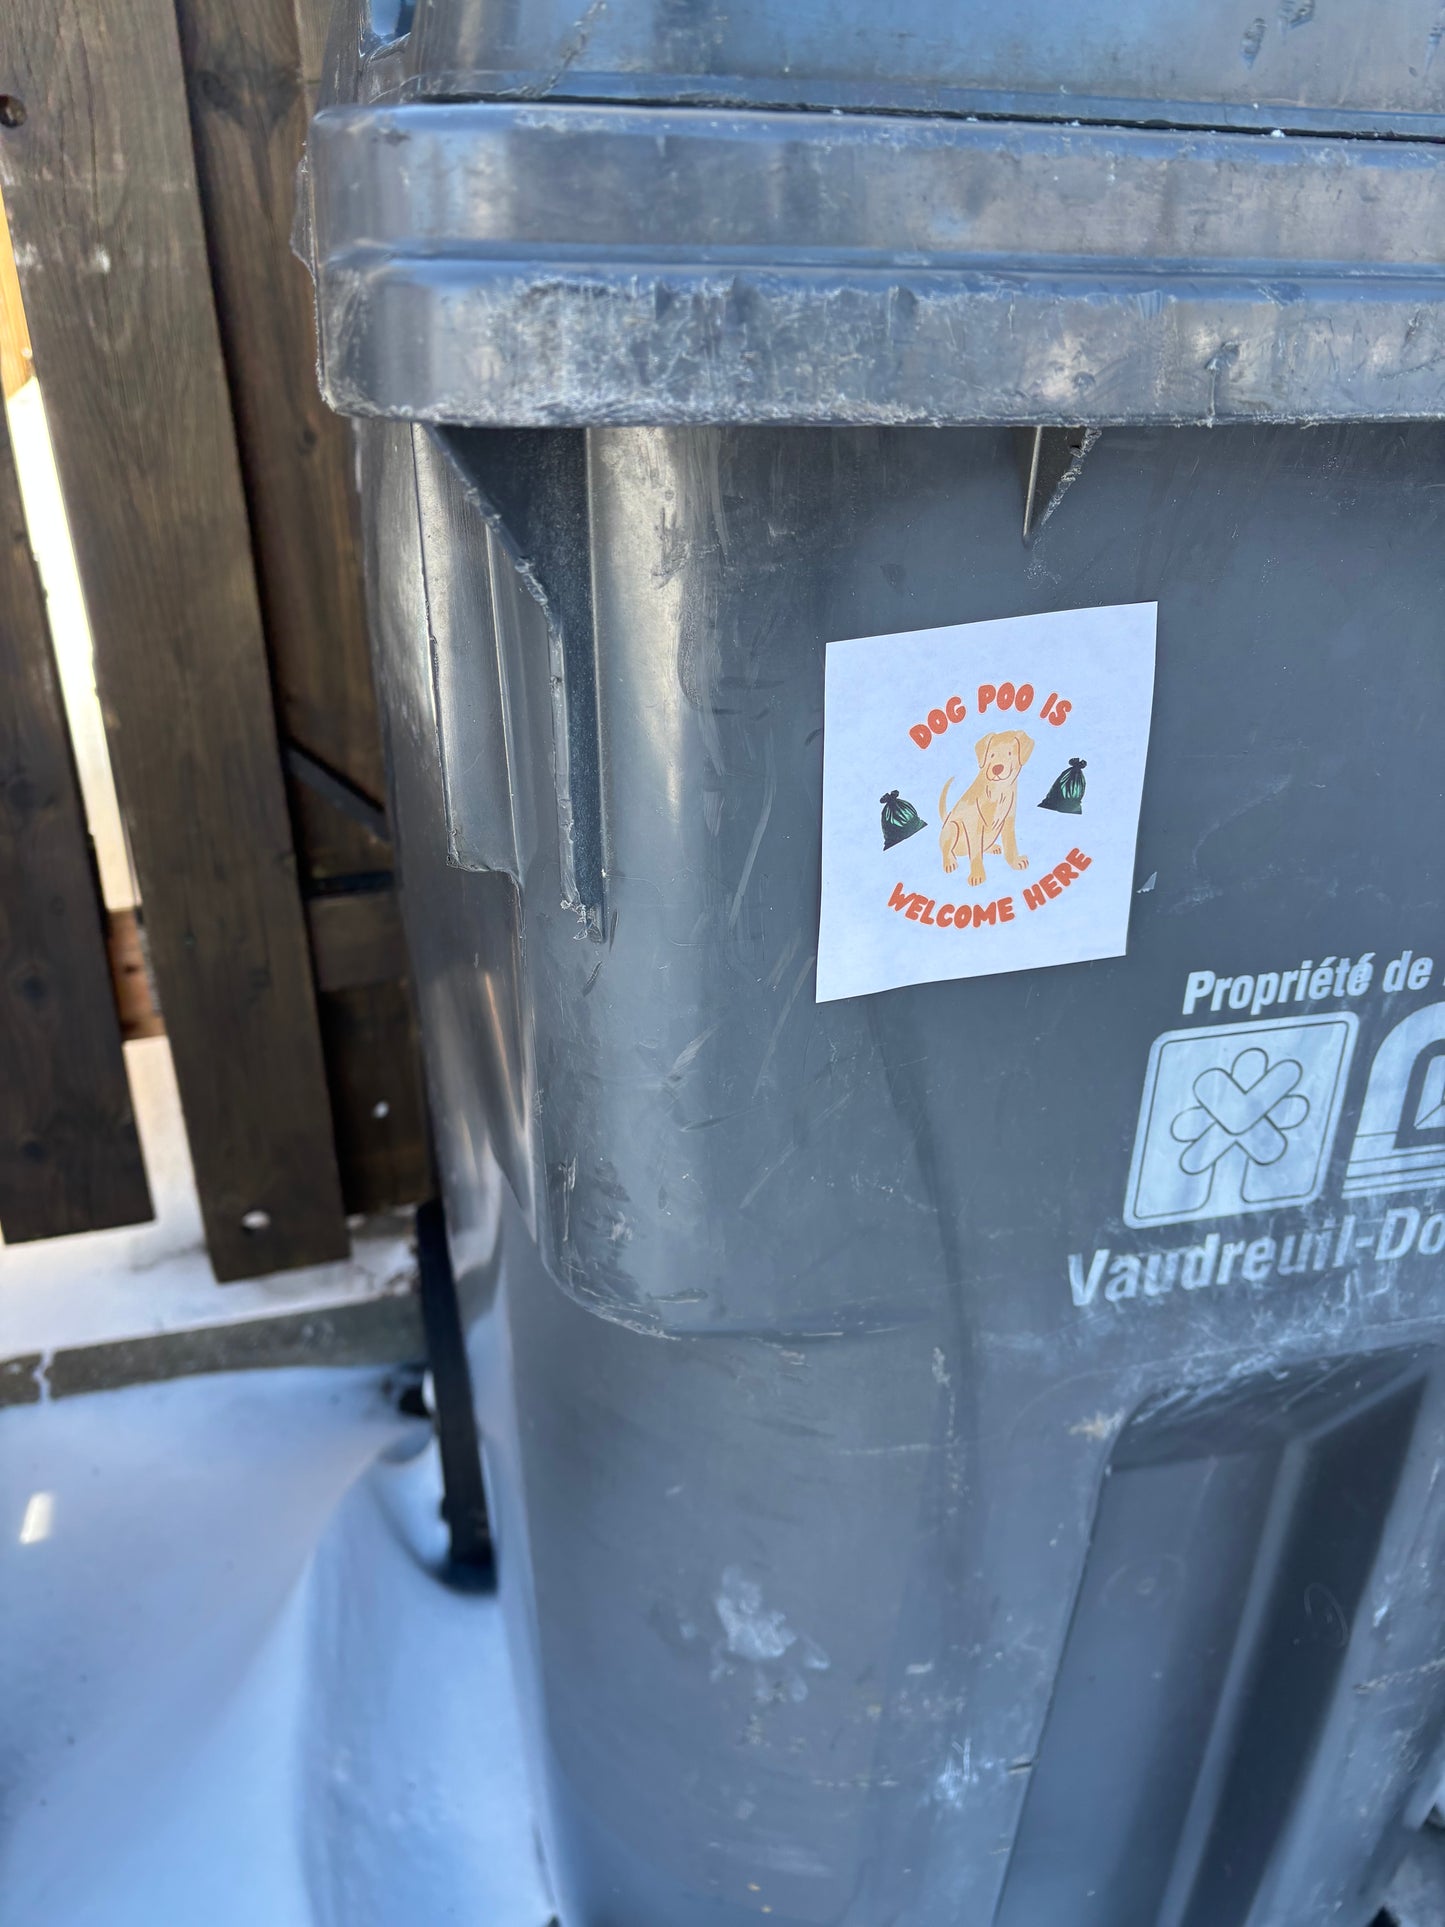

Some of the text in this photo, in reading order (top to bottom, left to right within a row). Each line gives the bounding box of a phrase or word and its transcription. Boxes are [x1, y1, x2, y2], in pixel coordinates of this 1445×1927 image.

[909, 682, 1073, 749] DOG POO IS
[887, 848, 1092, 929] WELCOME HERE
[1182, 950, 1433, 1015] Propriété de
